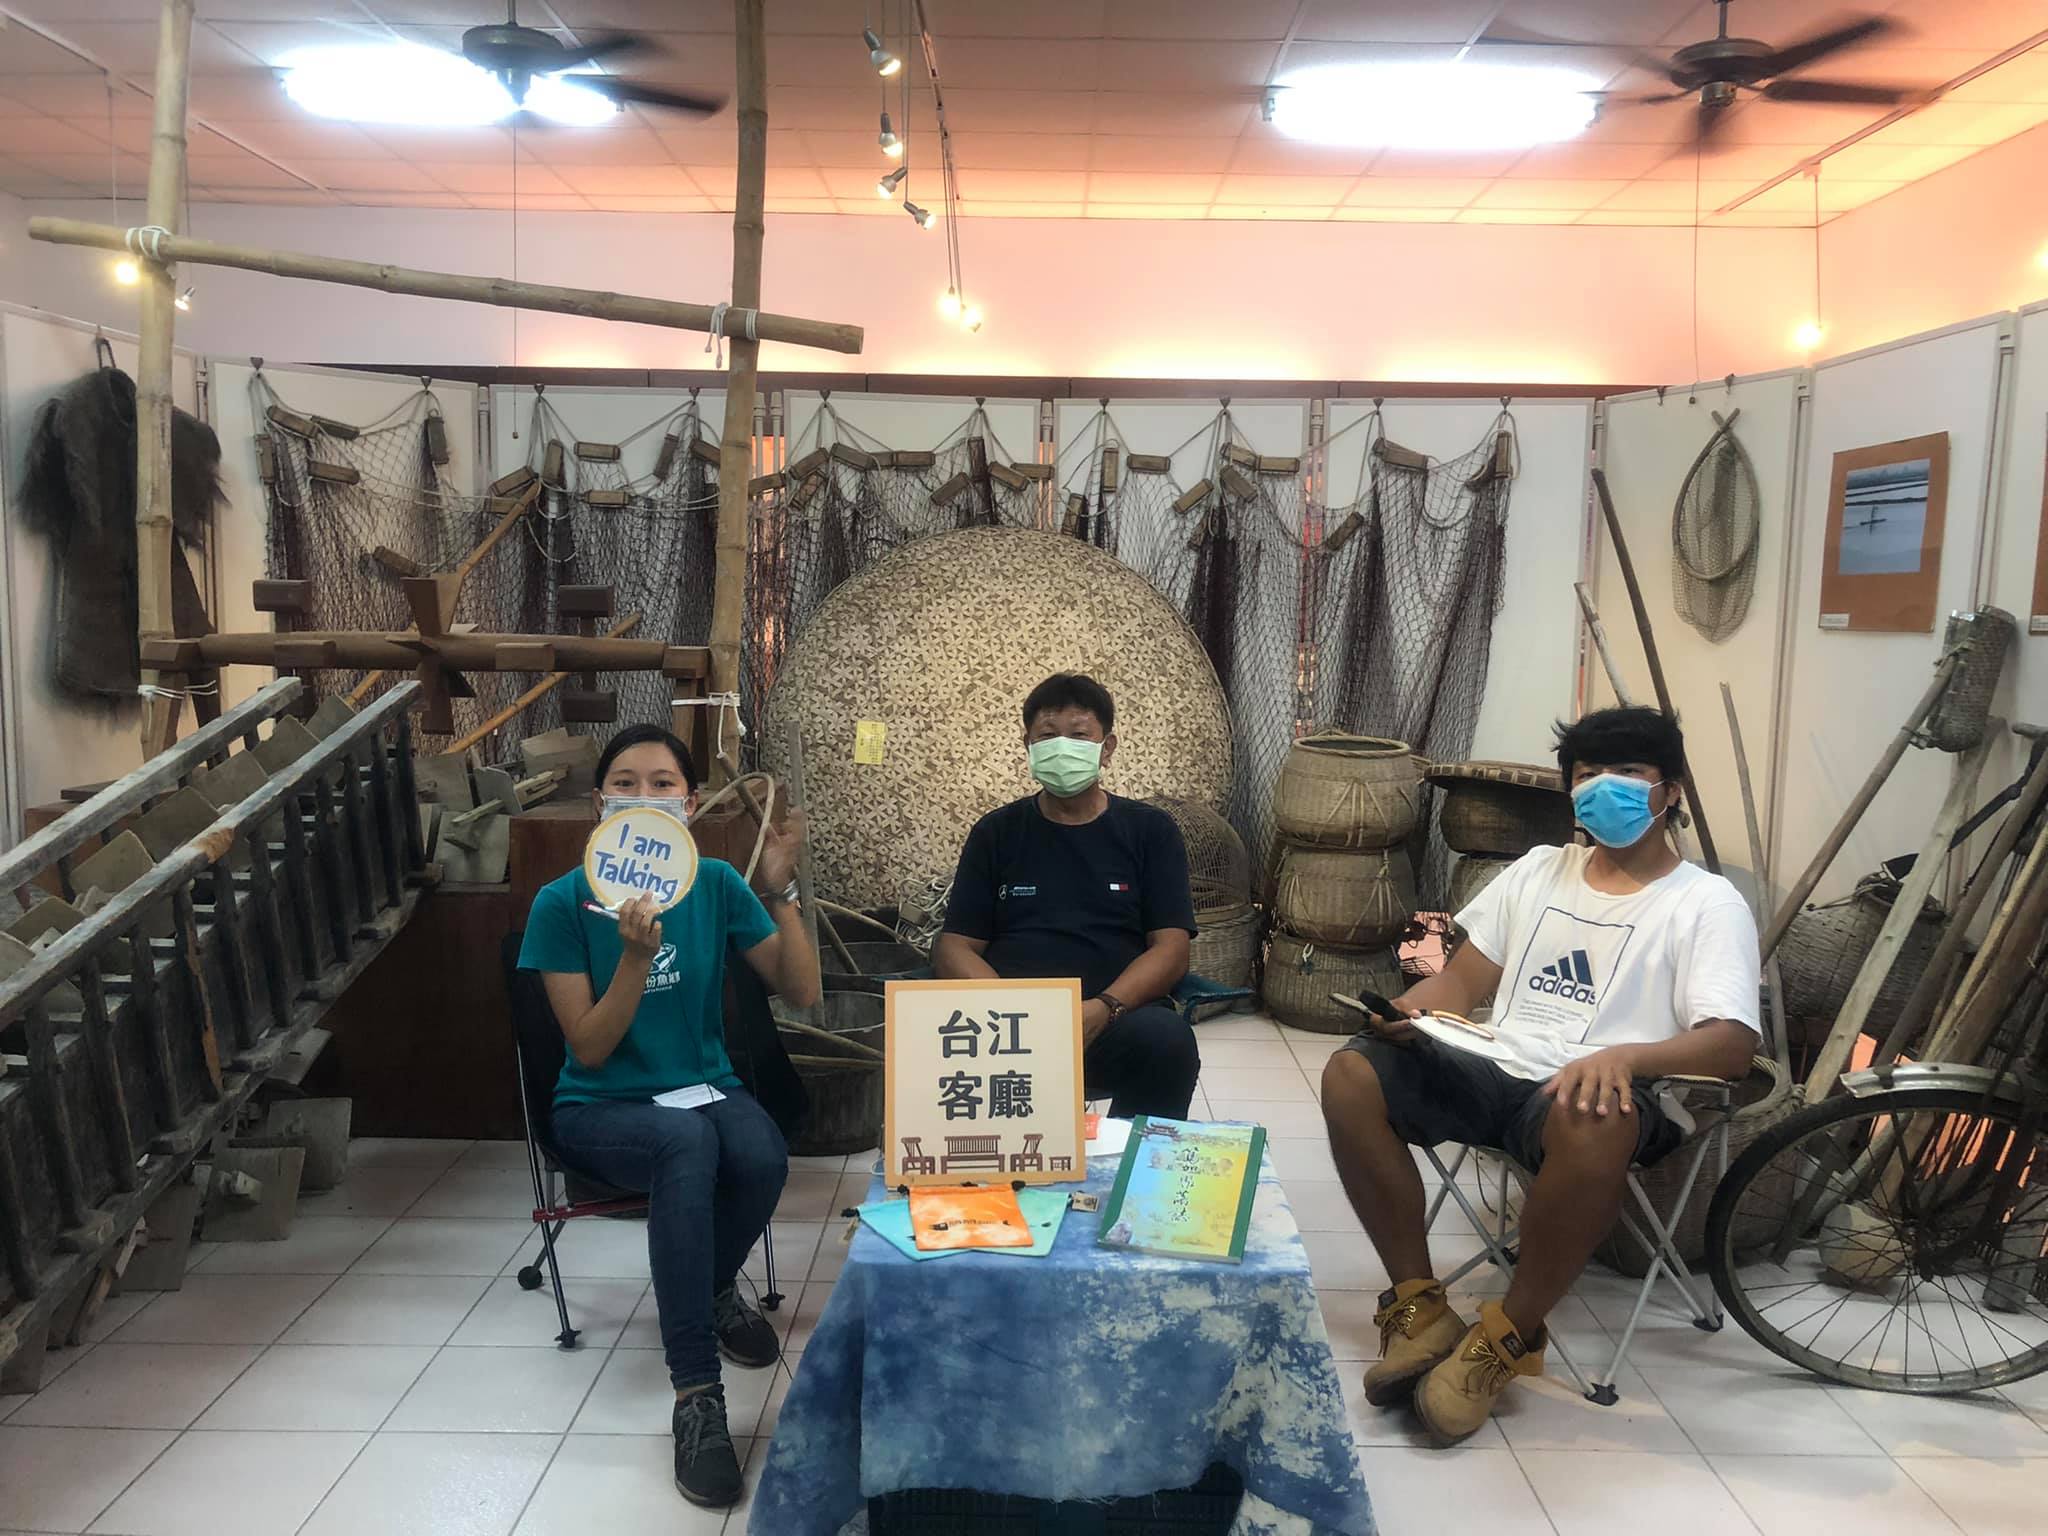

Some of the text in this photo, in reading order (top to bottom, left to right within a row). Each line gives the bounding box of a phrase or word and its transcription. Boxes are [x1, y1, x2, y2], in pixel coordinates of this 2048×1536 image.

[618, 823, 671, 861] I am
[595, 851, 678, 904] Talking
[1529, 975, 1596, 1005] adidas
[938, 1009, 1032, 1058] 台江
[937, 1070, 1034, 1120] 客廳
